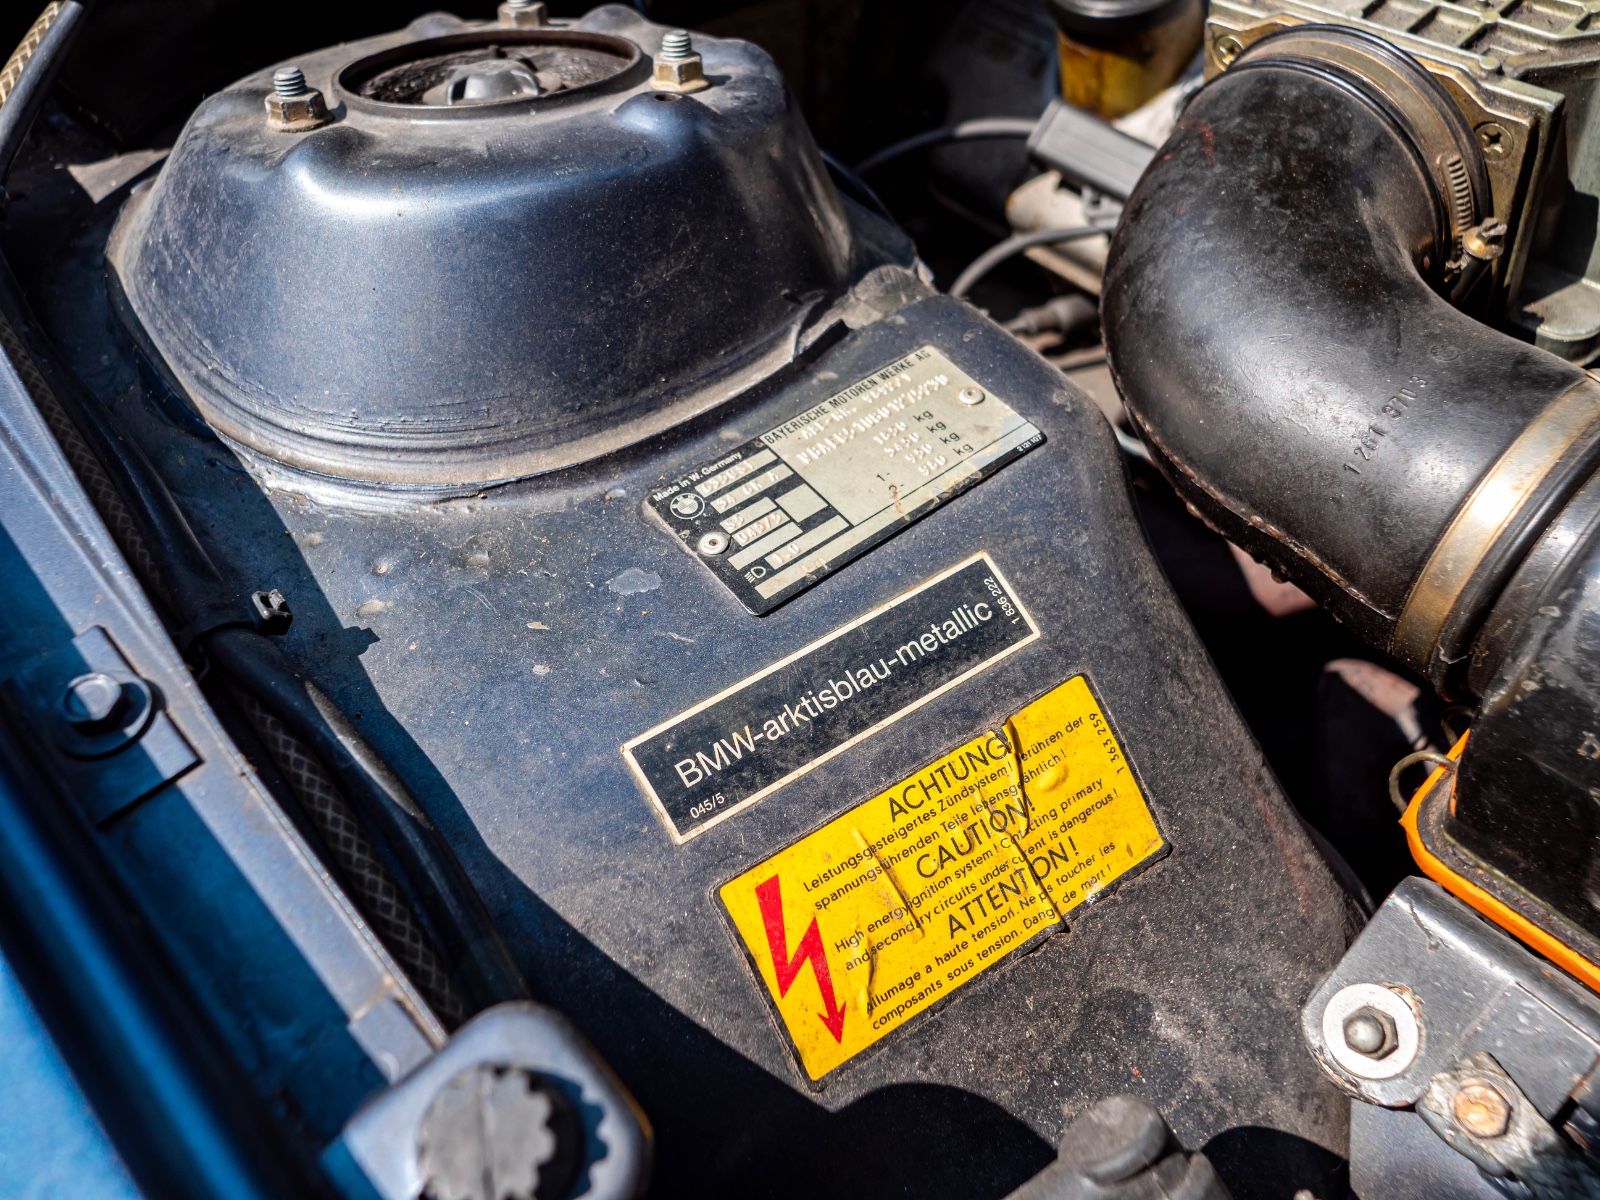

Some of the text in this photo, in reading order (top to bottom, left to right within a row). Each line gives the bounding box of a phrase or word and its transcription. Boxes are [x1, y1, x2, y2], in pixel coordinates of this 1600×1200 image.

[763, 405, 830, 444] BAYERISCHE
[827, 378, 879, 408] MOTOREN
[877, 358, 914, 381] WERKE
[912, 408, 935, 424] kg
[925, 419, 948, 435] kg
[938, 430, 961, 446] kg
[951, 441, 974, 457] kg
[652, 484, 680, 501] Made
[699, 450, 743, 477] Germany
[984, 576, 1002, 596] 222
[997, 596, 1015, 616] 836
[674, 600, 992, 788] BMW-arktisblau-metallic
[1089, 713, 1106, 735] 259
[1015, 731, 1063, 765] erühren
[1066, 717, 1082, 732] der
[1103, 739, 1119, 761] 363
[690, 792, 724, 818] 045/5
[940, 813, 968, 832] Teile
[835, 930, 864, 952] High
[955, 850, 993, 878] system
[1061, 779, 1102, 813] primary
[846, 949, 873, 970] and
[934, 883, 976, 914] circuits
[980, 861, 1009, 885] under
[1060, 794, 1113, 833] dangerous
[935, 941, 968, 966] haute
[972, 910, 1014, 942] tension.
[1019, 897, 1035, 909] Ne
[1057, 855, 1094, 885] toucher
[1099, 843, 1115, 856] les
[873, 980, 942, 1029] composants
[948, 960, 974, 980] sous
[977, 931, 1022, 960] tension.
[1063, 891, 1076, 903] de
[1081, 870, 1104, 889] mort
